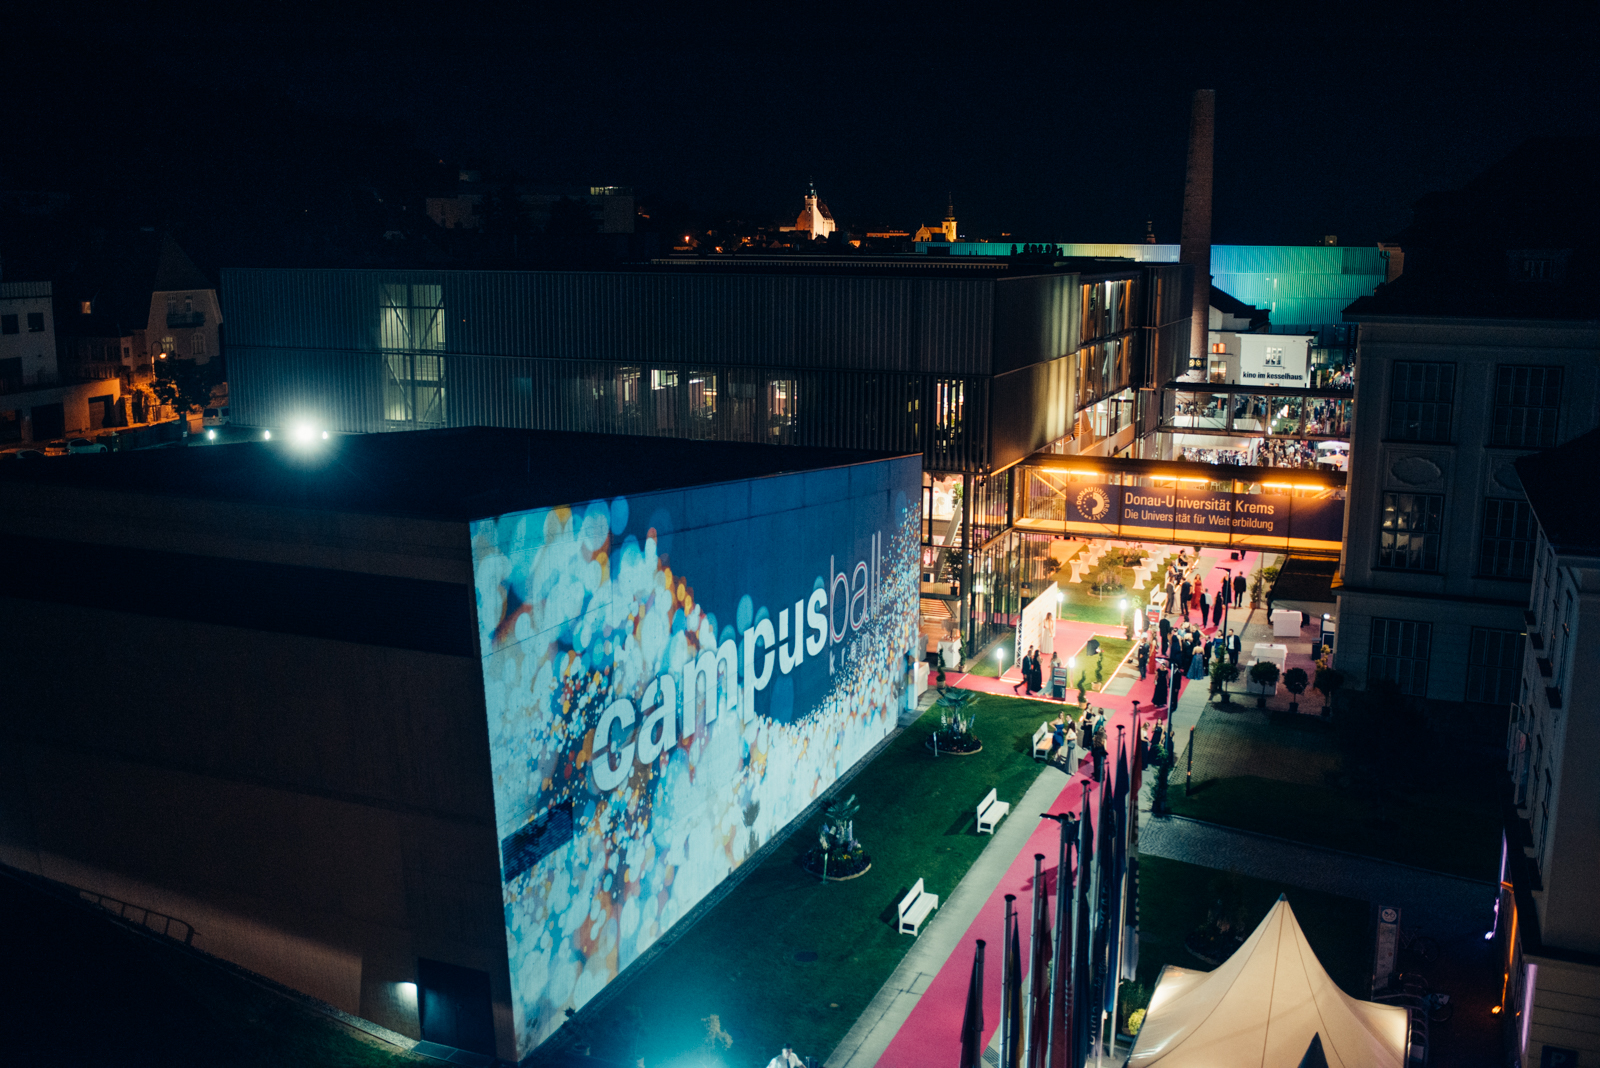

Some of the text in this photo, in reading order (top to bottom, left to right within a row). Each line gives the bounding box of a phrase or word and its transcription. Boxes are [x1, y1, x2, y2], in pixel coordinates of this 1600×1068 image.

[1243, 371, 1303, 380] kino im kesselhaus
[1124, 492, 1275, 515] Donau-Universität Krems
[1124, 508, 1274, 532] Die Universität für Weiterbildung
